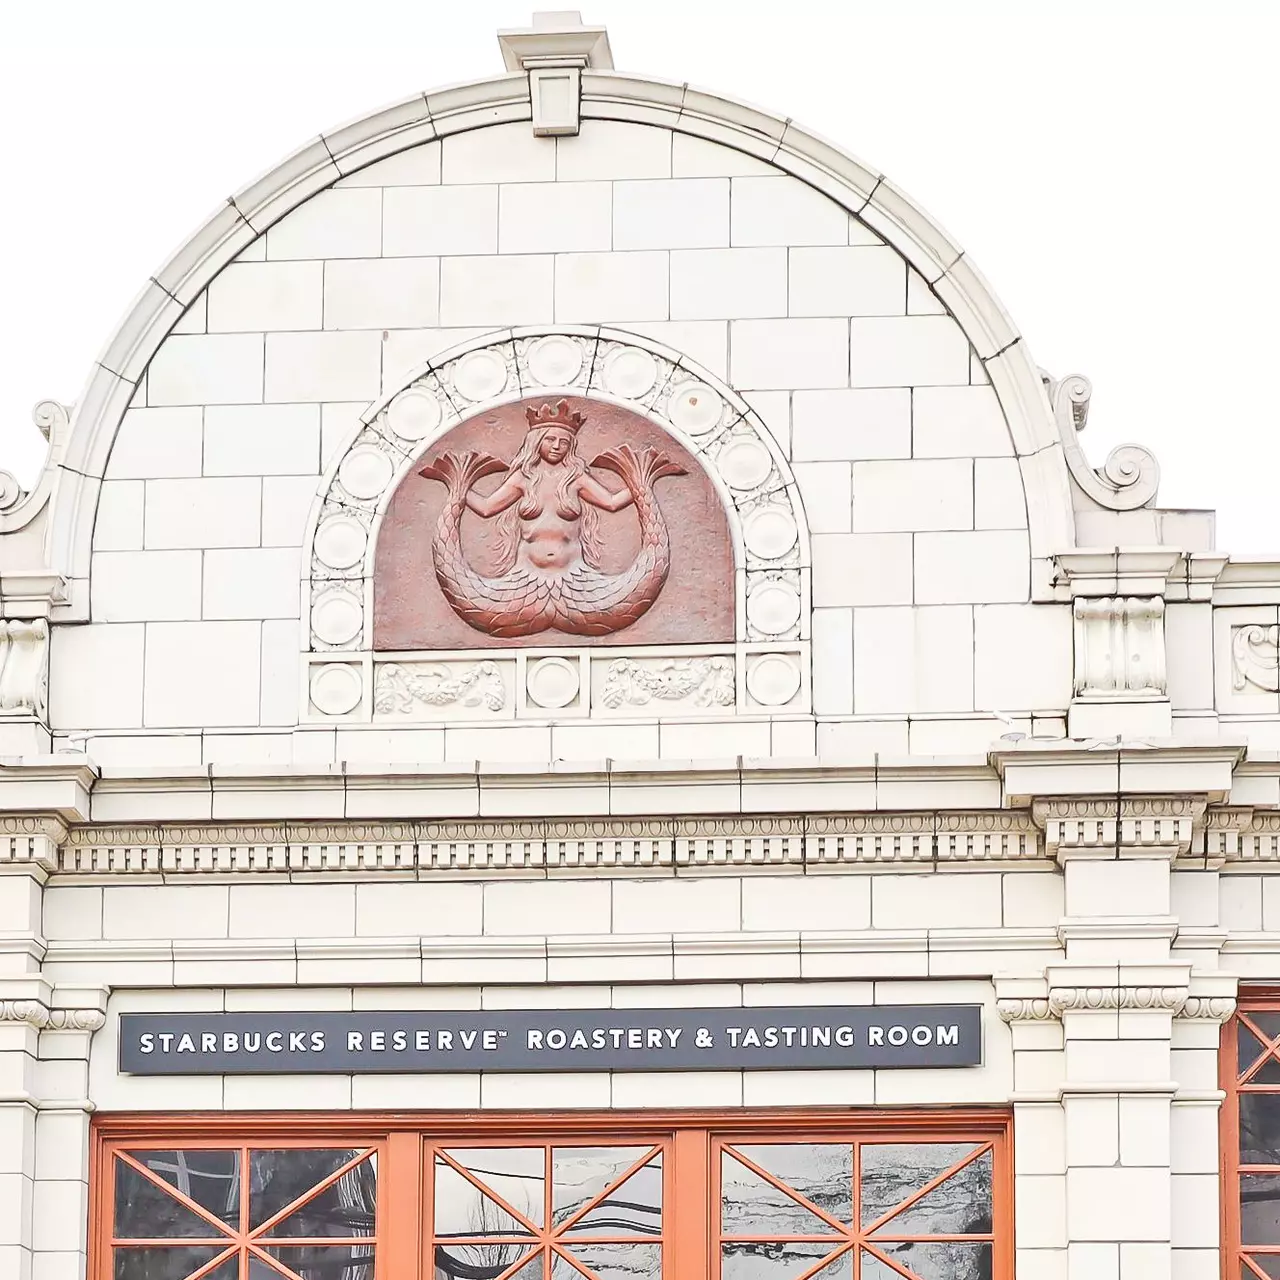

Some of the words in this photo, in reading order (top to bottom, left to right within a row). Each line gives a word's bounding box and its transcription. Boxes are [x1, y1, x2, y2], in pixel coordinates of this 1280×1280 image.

[139, 1030, 326, 1054] STARBUCKS
[527, 1028, 683, 1050] ROASTERY
[694, 1028, 714, 1049] &
[726, 1026, 855, 1048] TASTING
[868, 1025, 960, 1046] ROOM
